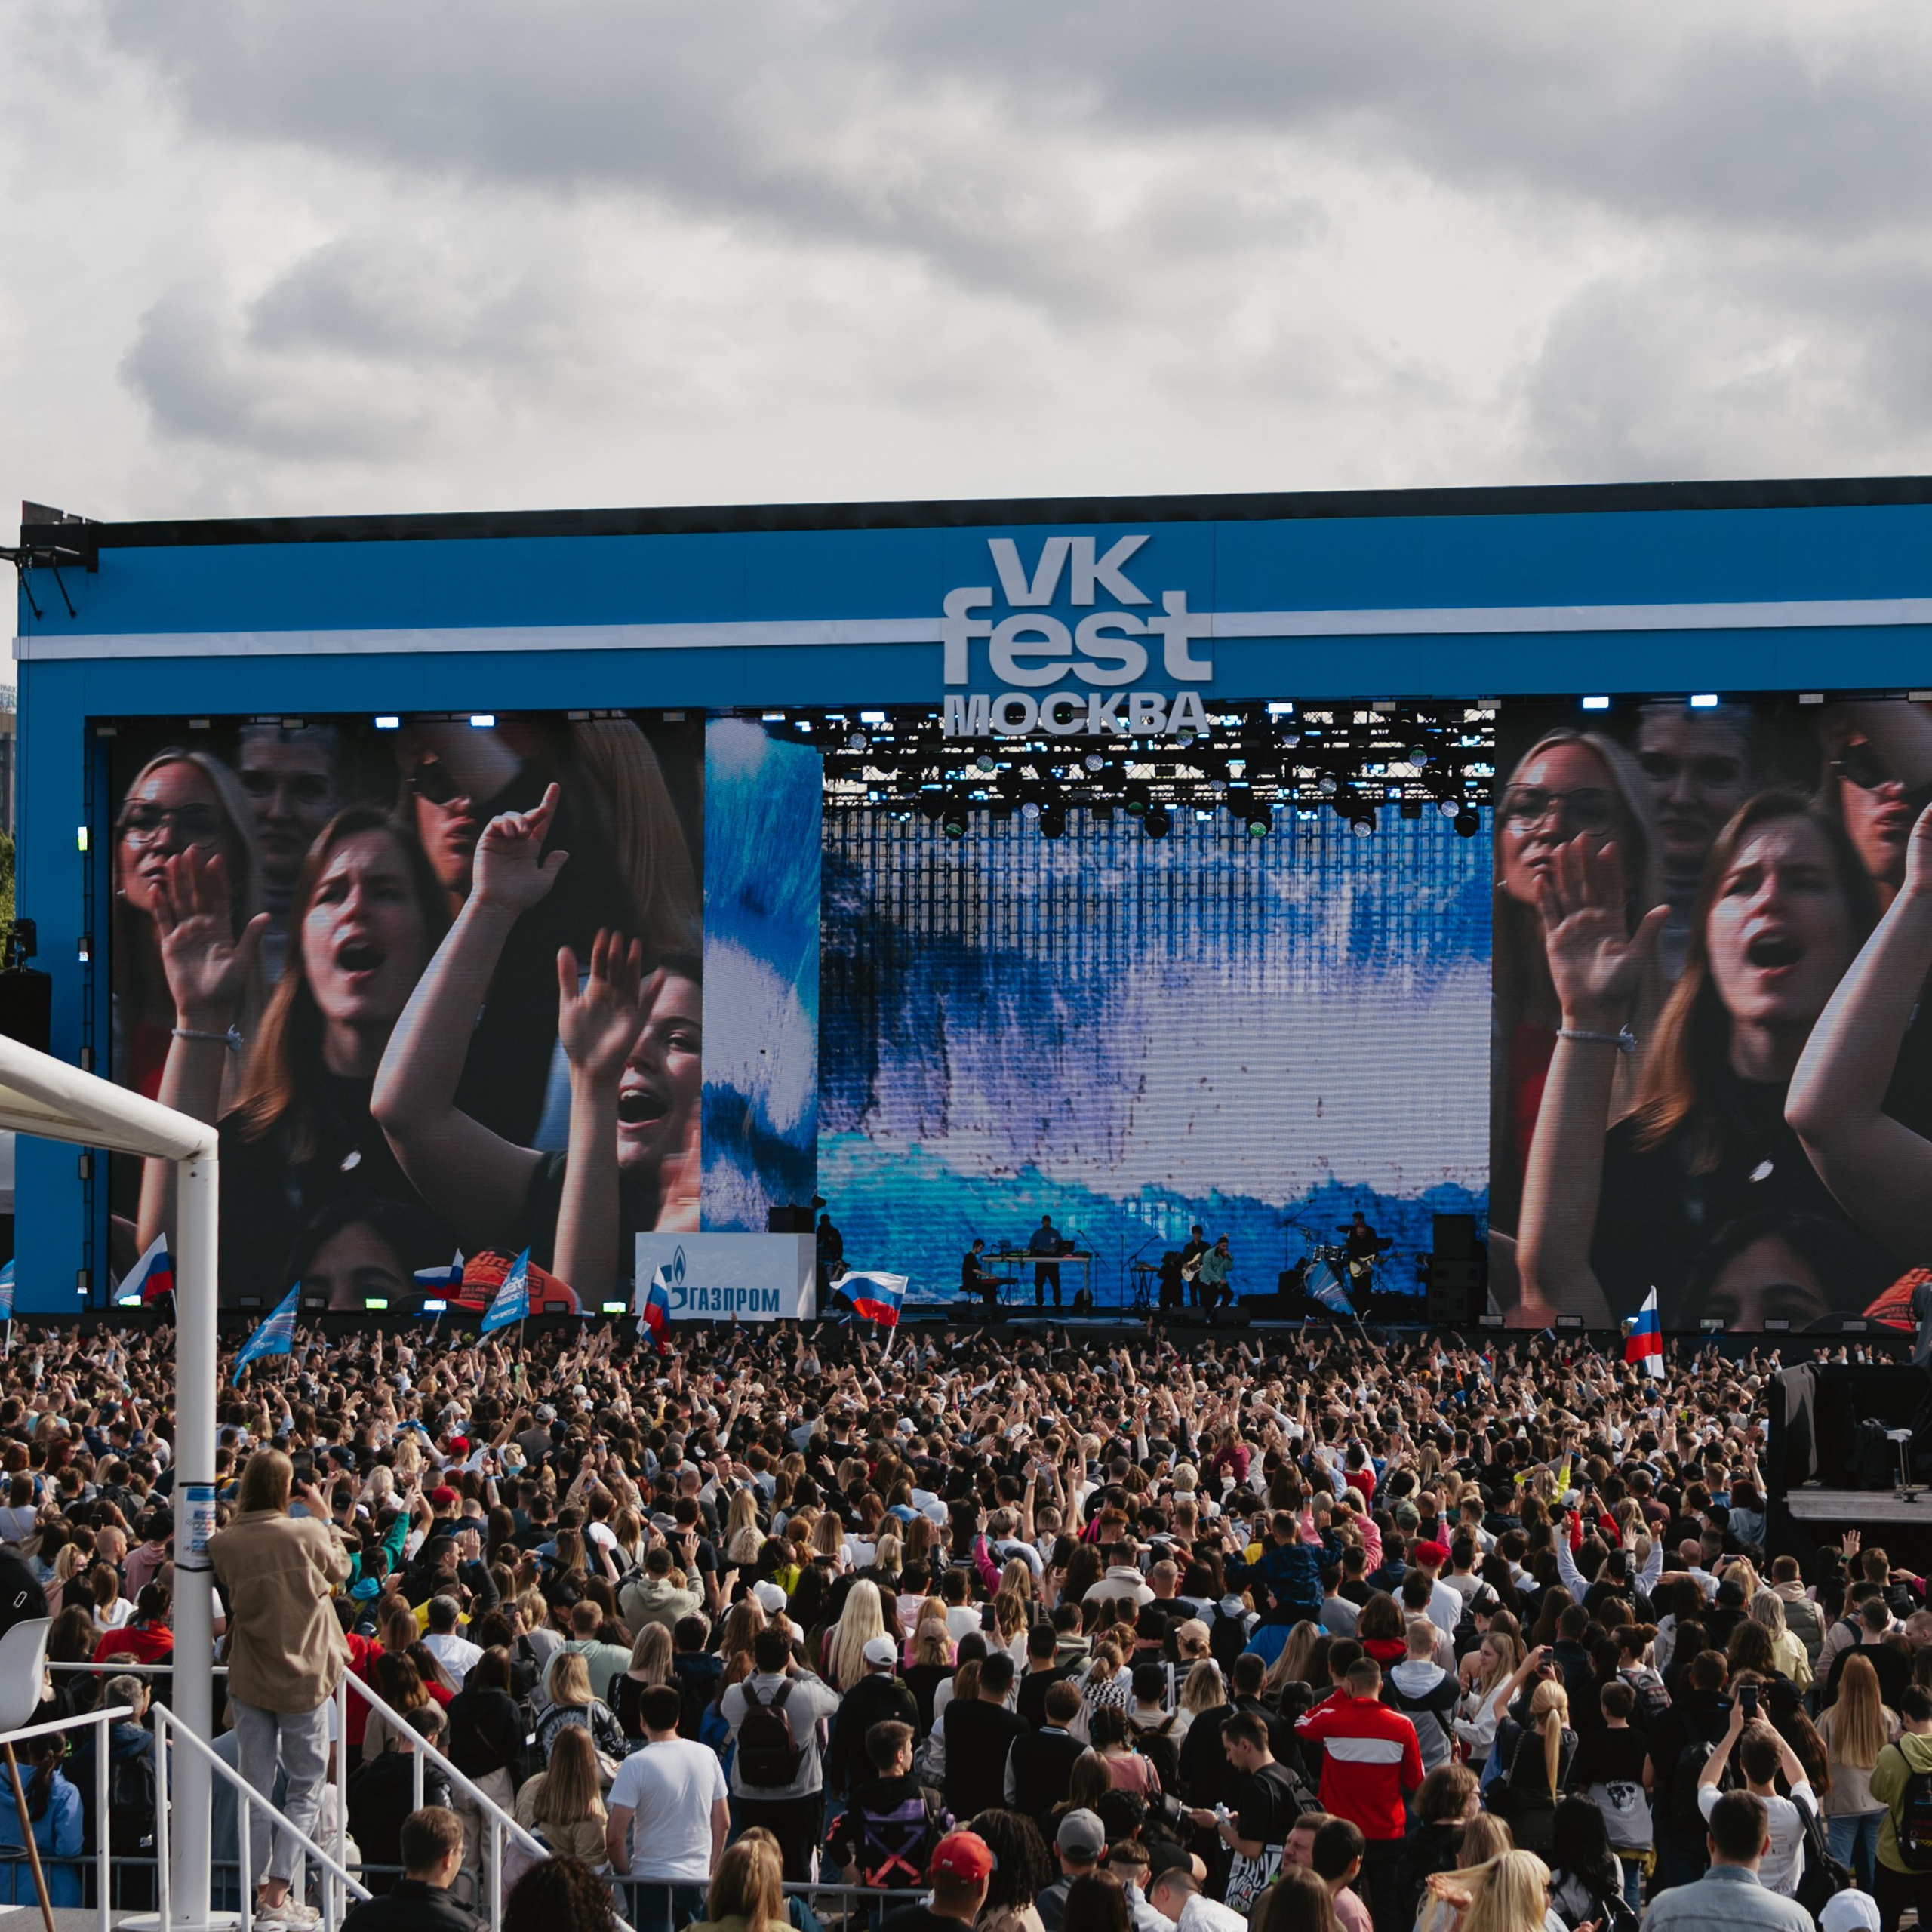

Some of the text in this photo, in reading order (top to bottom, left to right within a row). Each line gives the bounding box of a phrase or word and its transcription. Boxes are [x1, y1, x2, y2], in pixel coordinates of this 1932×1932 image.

[987, 534, 1152, 607] VK
[943, 586, 1213, 687] fest
[943, 691, 1211, 737] МОСКВА
[689, 1287, 780, 1312] ГАЗПРОМ
